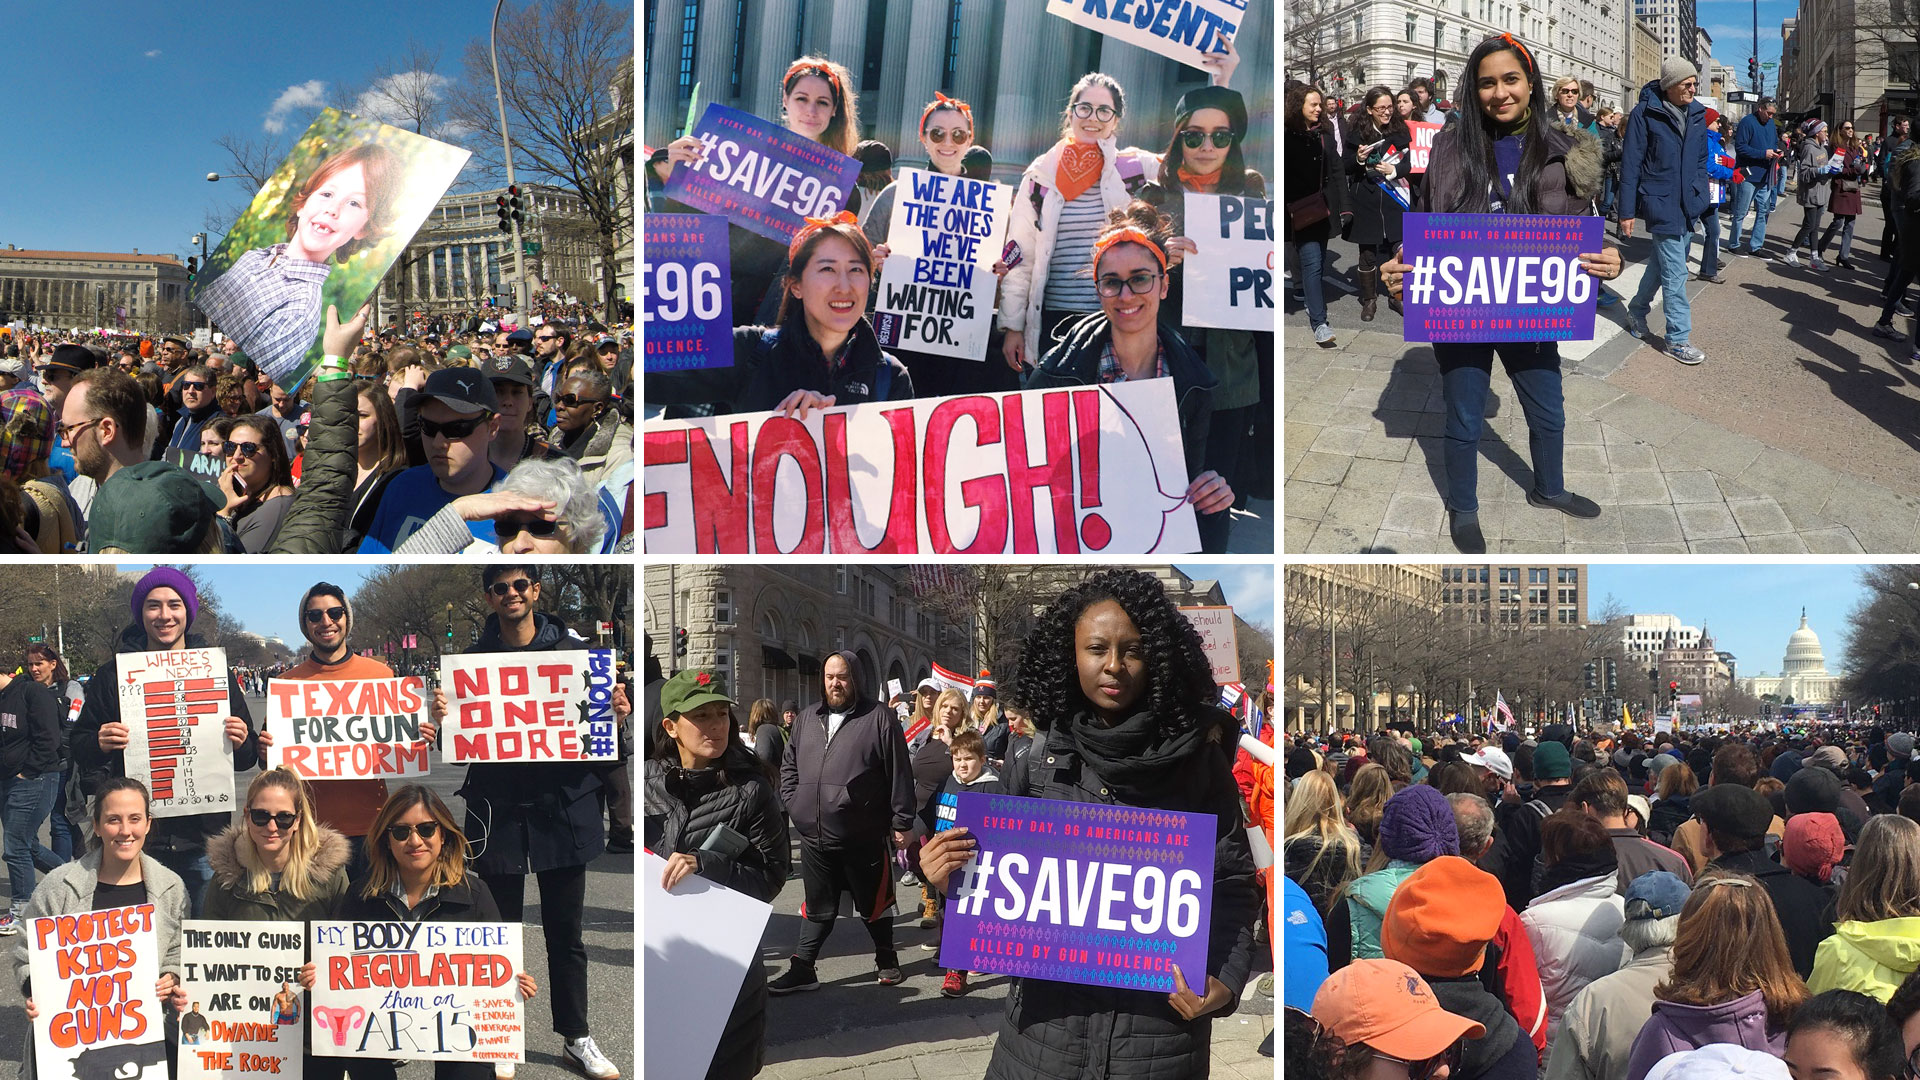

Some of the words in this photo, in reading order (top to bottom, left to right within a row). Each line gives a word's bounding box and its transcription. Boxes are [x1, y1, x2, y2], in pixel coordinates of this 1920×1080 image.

[1060, 0, 1237, 54] RESENTE
[718, 117, 743, 132] EVERY
[747, 127, 762, 141] DAY,
[781, 141, 826, 167] AMERICANS
[828, 162, 843, 175] ARE
[1416, 127, 1440, 147] NO
[683, 131, 842, 219] #SAVE96
[685, 183, 723, 203] KILLED
[725, 199, 739, 211] BY
[742, 206, 760, 222] GUN
[912, 172, 949, 204] WE
[951, 179, 997, 213] ARE
[903, 201, 940, 229] THE
[943, 208, 993, 237] ONES
[1424, 230, 1455, 240] EVERY
[1460, 231, 1482, 241] DAY,
[1487, 231, 1499, 240] 96
[1504, 231, 1561, 241] AMERICANS
[1565, 232, 1584, 241] ARE
[682, 233, 705, 243] ARE
[922, 230, 981, 263] WE'VE
[914, 257, 974, 289] BEEN
[1229, 267, 1274, 308] PR
[1409, 255, 1591, 305] #SAVE96
[886, 283, 974, 319] WAITING
[903, 314, 959, 347] FOR.
[1424, 319, 1464, 330] KILLED
[1471, 319, 1485, 329] BY
[1490, 319, 1512, 329] GUN
[1518, 318, 1576, 329] VIOLENCE.
[646, 339, 710, 354] OLENCE.
[644, 389, 1112, 554] ENOUGH!
[146, 651, 210, 667] WHERE'S
[166, 665, 212, 679] NEXT?
[270, 676, 424, 718] TEXANS
[453, 664, 574, 699] NOT.
[460, 700, 574, 729] ONE.
[588, 648, 615, 757] #ENOUGH
[292, 717, 344, 744] FOR
[346, 713, 420, 743] GUN
[454, 729, 588, 761] MORE.
[182, 757, 193, 766] 17
[184, 768, 193, 776] 14
[282, 741, 428, 777] REFORM
[163, 798, 173, 806] 10
[178, 797, 188, 805] 20
[191, 796, 201, 804] 30
[204, 794, 214, 803] 40
[218, 793, 229, 802] 50
[184, 779, 194, 788] 13
[186, 788, 195, 797] 13
[984, 815, 1023, 831] EVERY
[1030, 820, 1057, 836] DAY,
[1064, 823, 1080, 836] 96
[1086, 826, 1160, 845] AMERICANS
[1166, 834, 1190, 848] ARE
[956, 849, 1202, 938] #SAVE96
[35, 904, 155, 950] PROTECT
[183, 929, 212, 948] THE
[214, 931, 251, 949] ONLY
[257, 932, 302, 950] GUNS
[317, 926, 349, 946] MY
[353, 922, 422, 950] BODY
[427, 926, 447, 947] IS
[455, 926, 509, 947] MORE
[57, 939, 137, 979] KIDS
[970, 937, 1023, 957] KILLED
[1032, 944, 1051, 960] BY
[1059, 947, 1089, 964] GUN
[184, 963, 198, 982] I
[203, 963, 251, 982] WANT
[252, 965, 271, 981] TO
[273, 966, 302, 984] SEE
[328, 953, 514, 990] REGULATED
[67, 971, 132, 1009] NOT
[208, 993, 242, 1012] ARE
[248, 995, 271, 1011] ON
[379, 990, 431, 1010] than
[433, 993, 465, 1009] an
[49, 999, 147, 1048] GUNS
[211, 1020, 279, 1043] DWAYNE
[355, 1010, 477, 1053] AR-15
